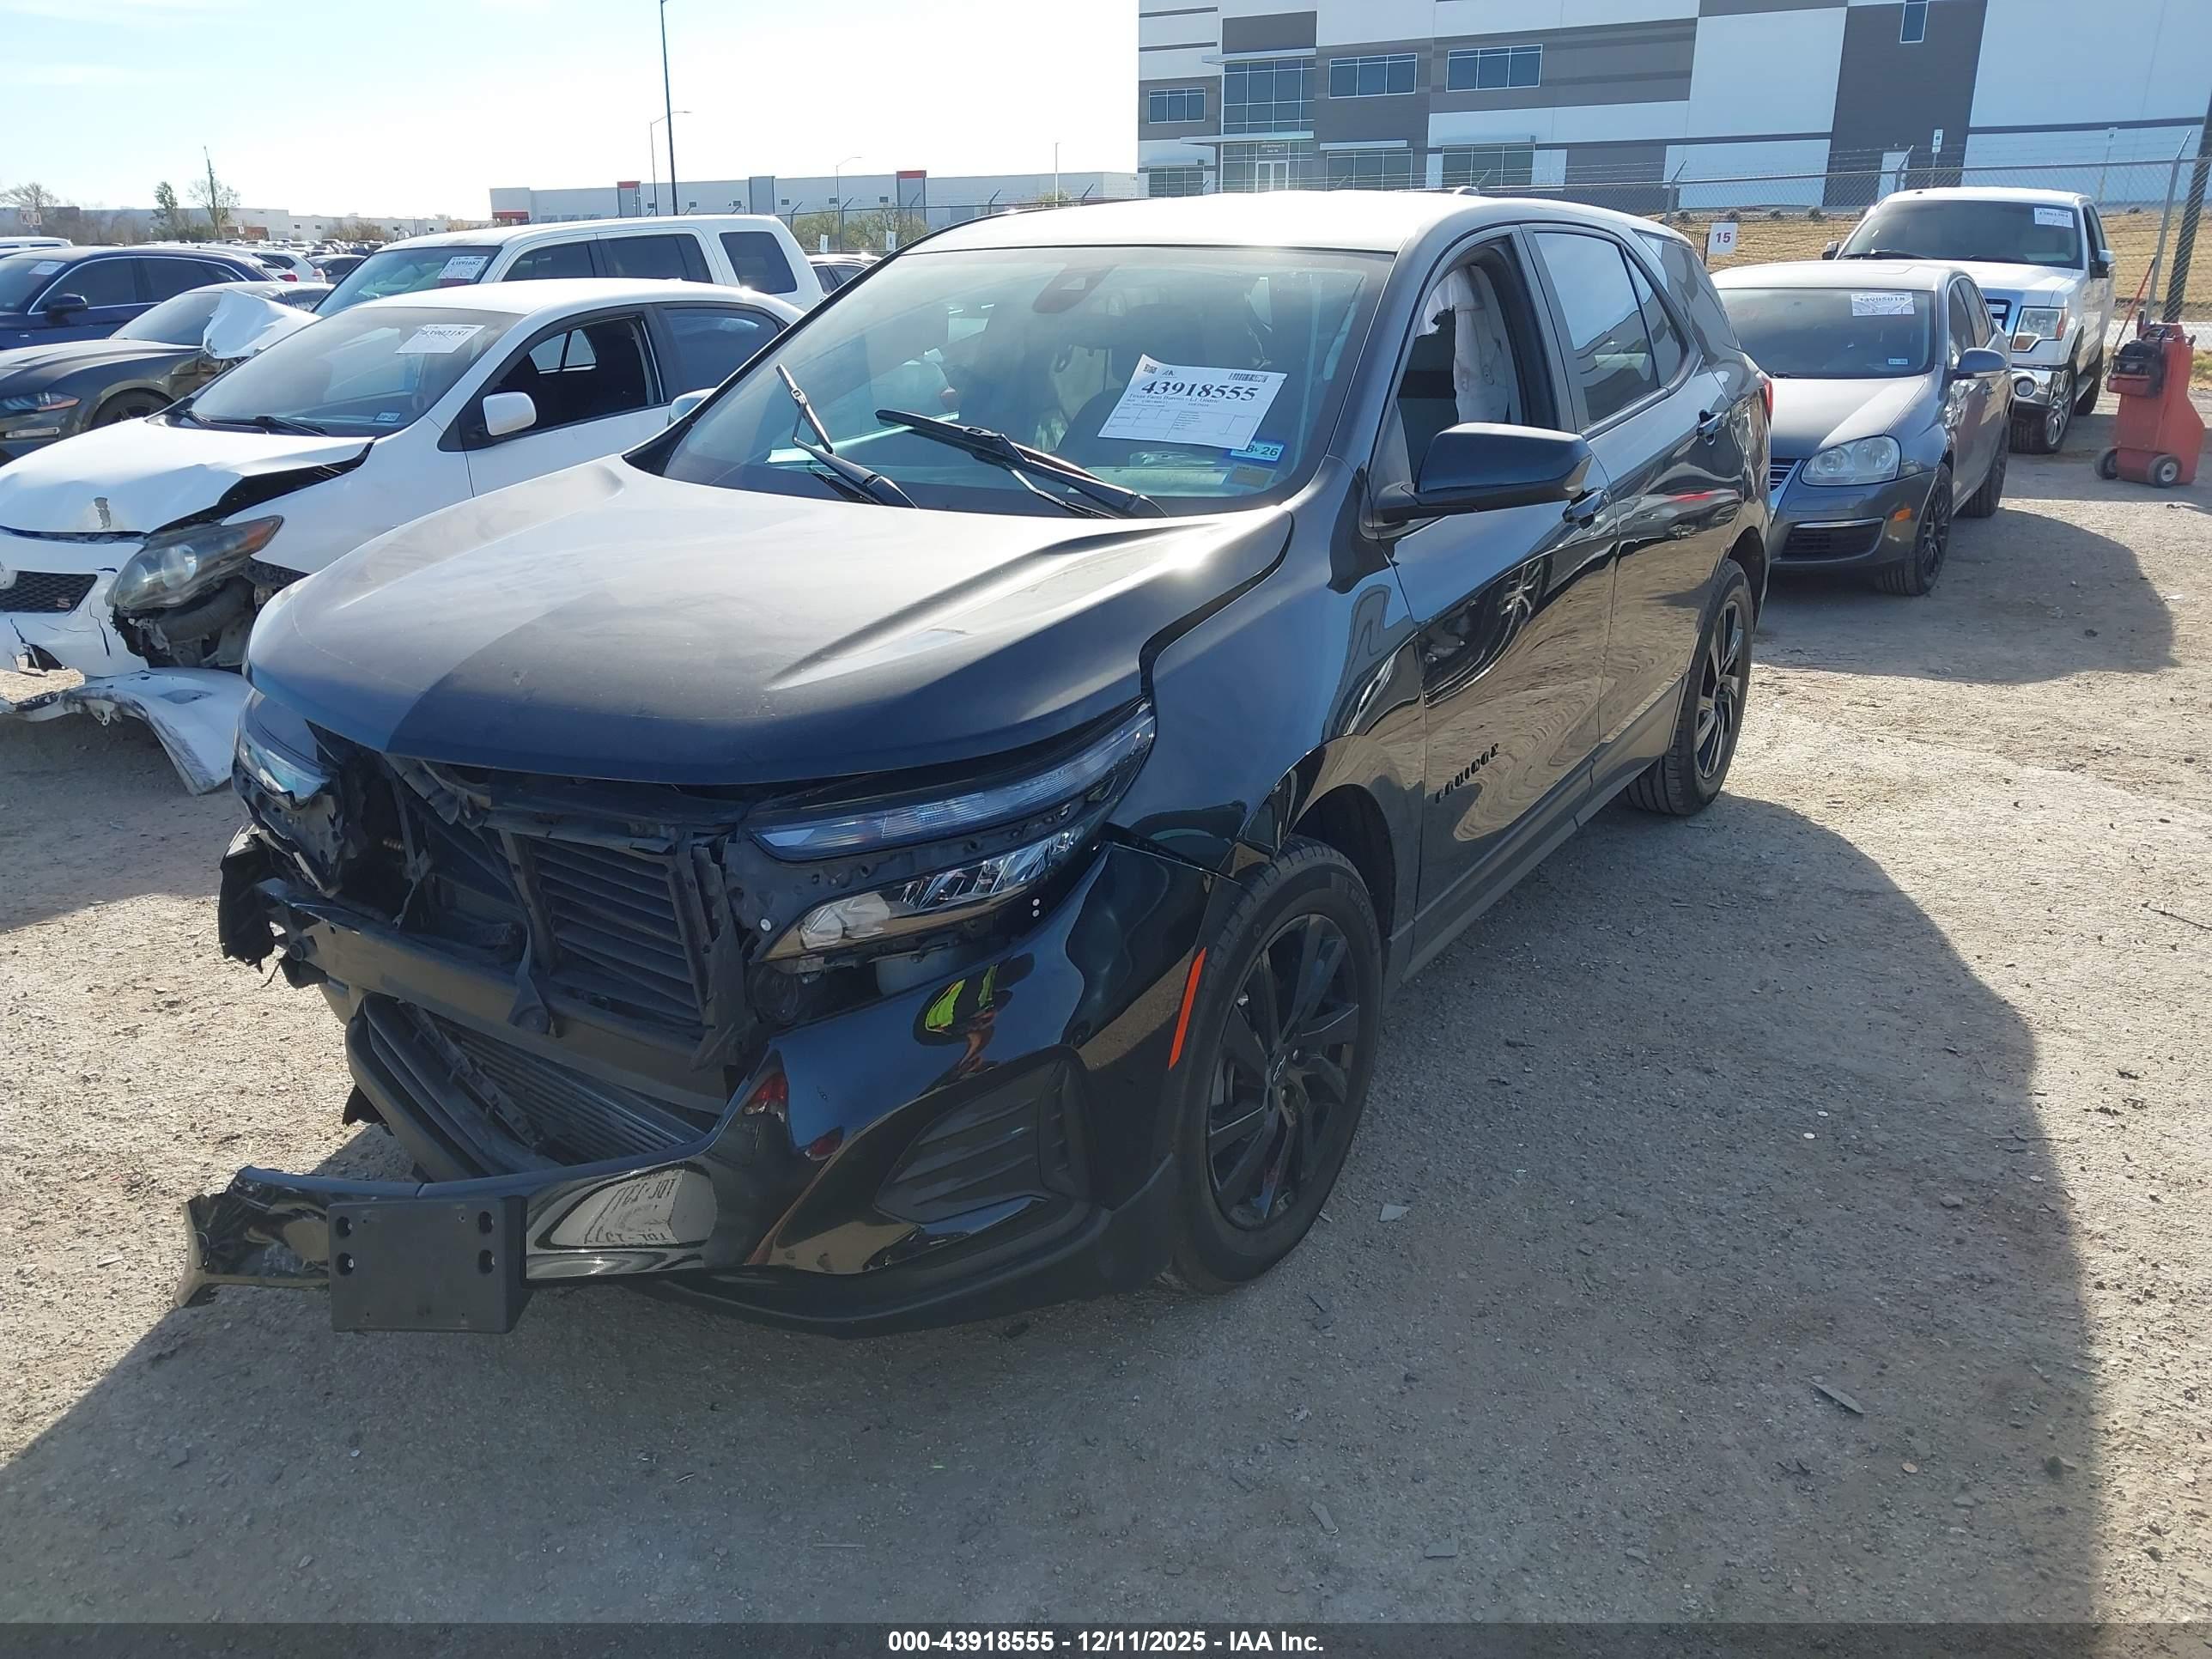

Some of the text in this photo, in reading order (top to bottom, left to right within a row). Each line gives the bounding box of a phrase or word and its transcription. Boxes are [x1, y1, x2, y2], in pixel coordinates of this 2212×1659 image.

[21, 213, 28, 223] K
[1716, 232, 1732, 243] 15
[1141, 380, 1260, 401] 43918555
[1261, 447, 1279, 456] 26
[57, 598, 70, 608] S
